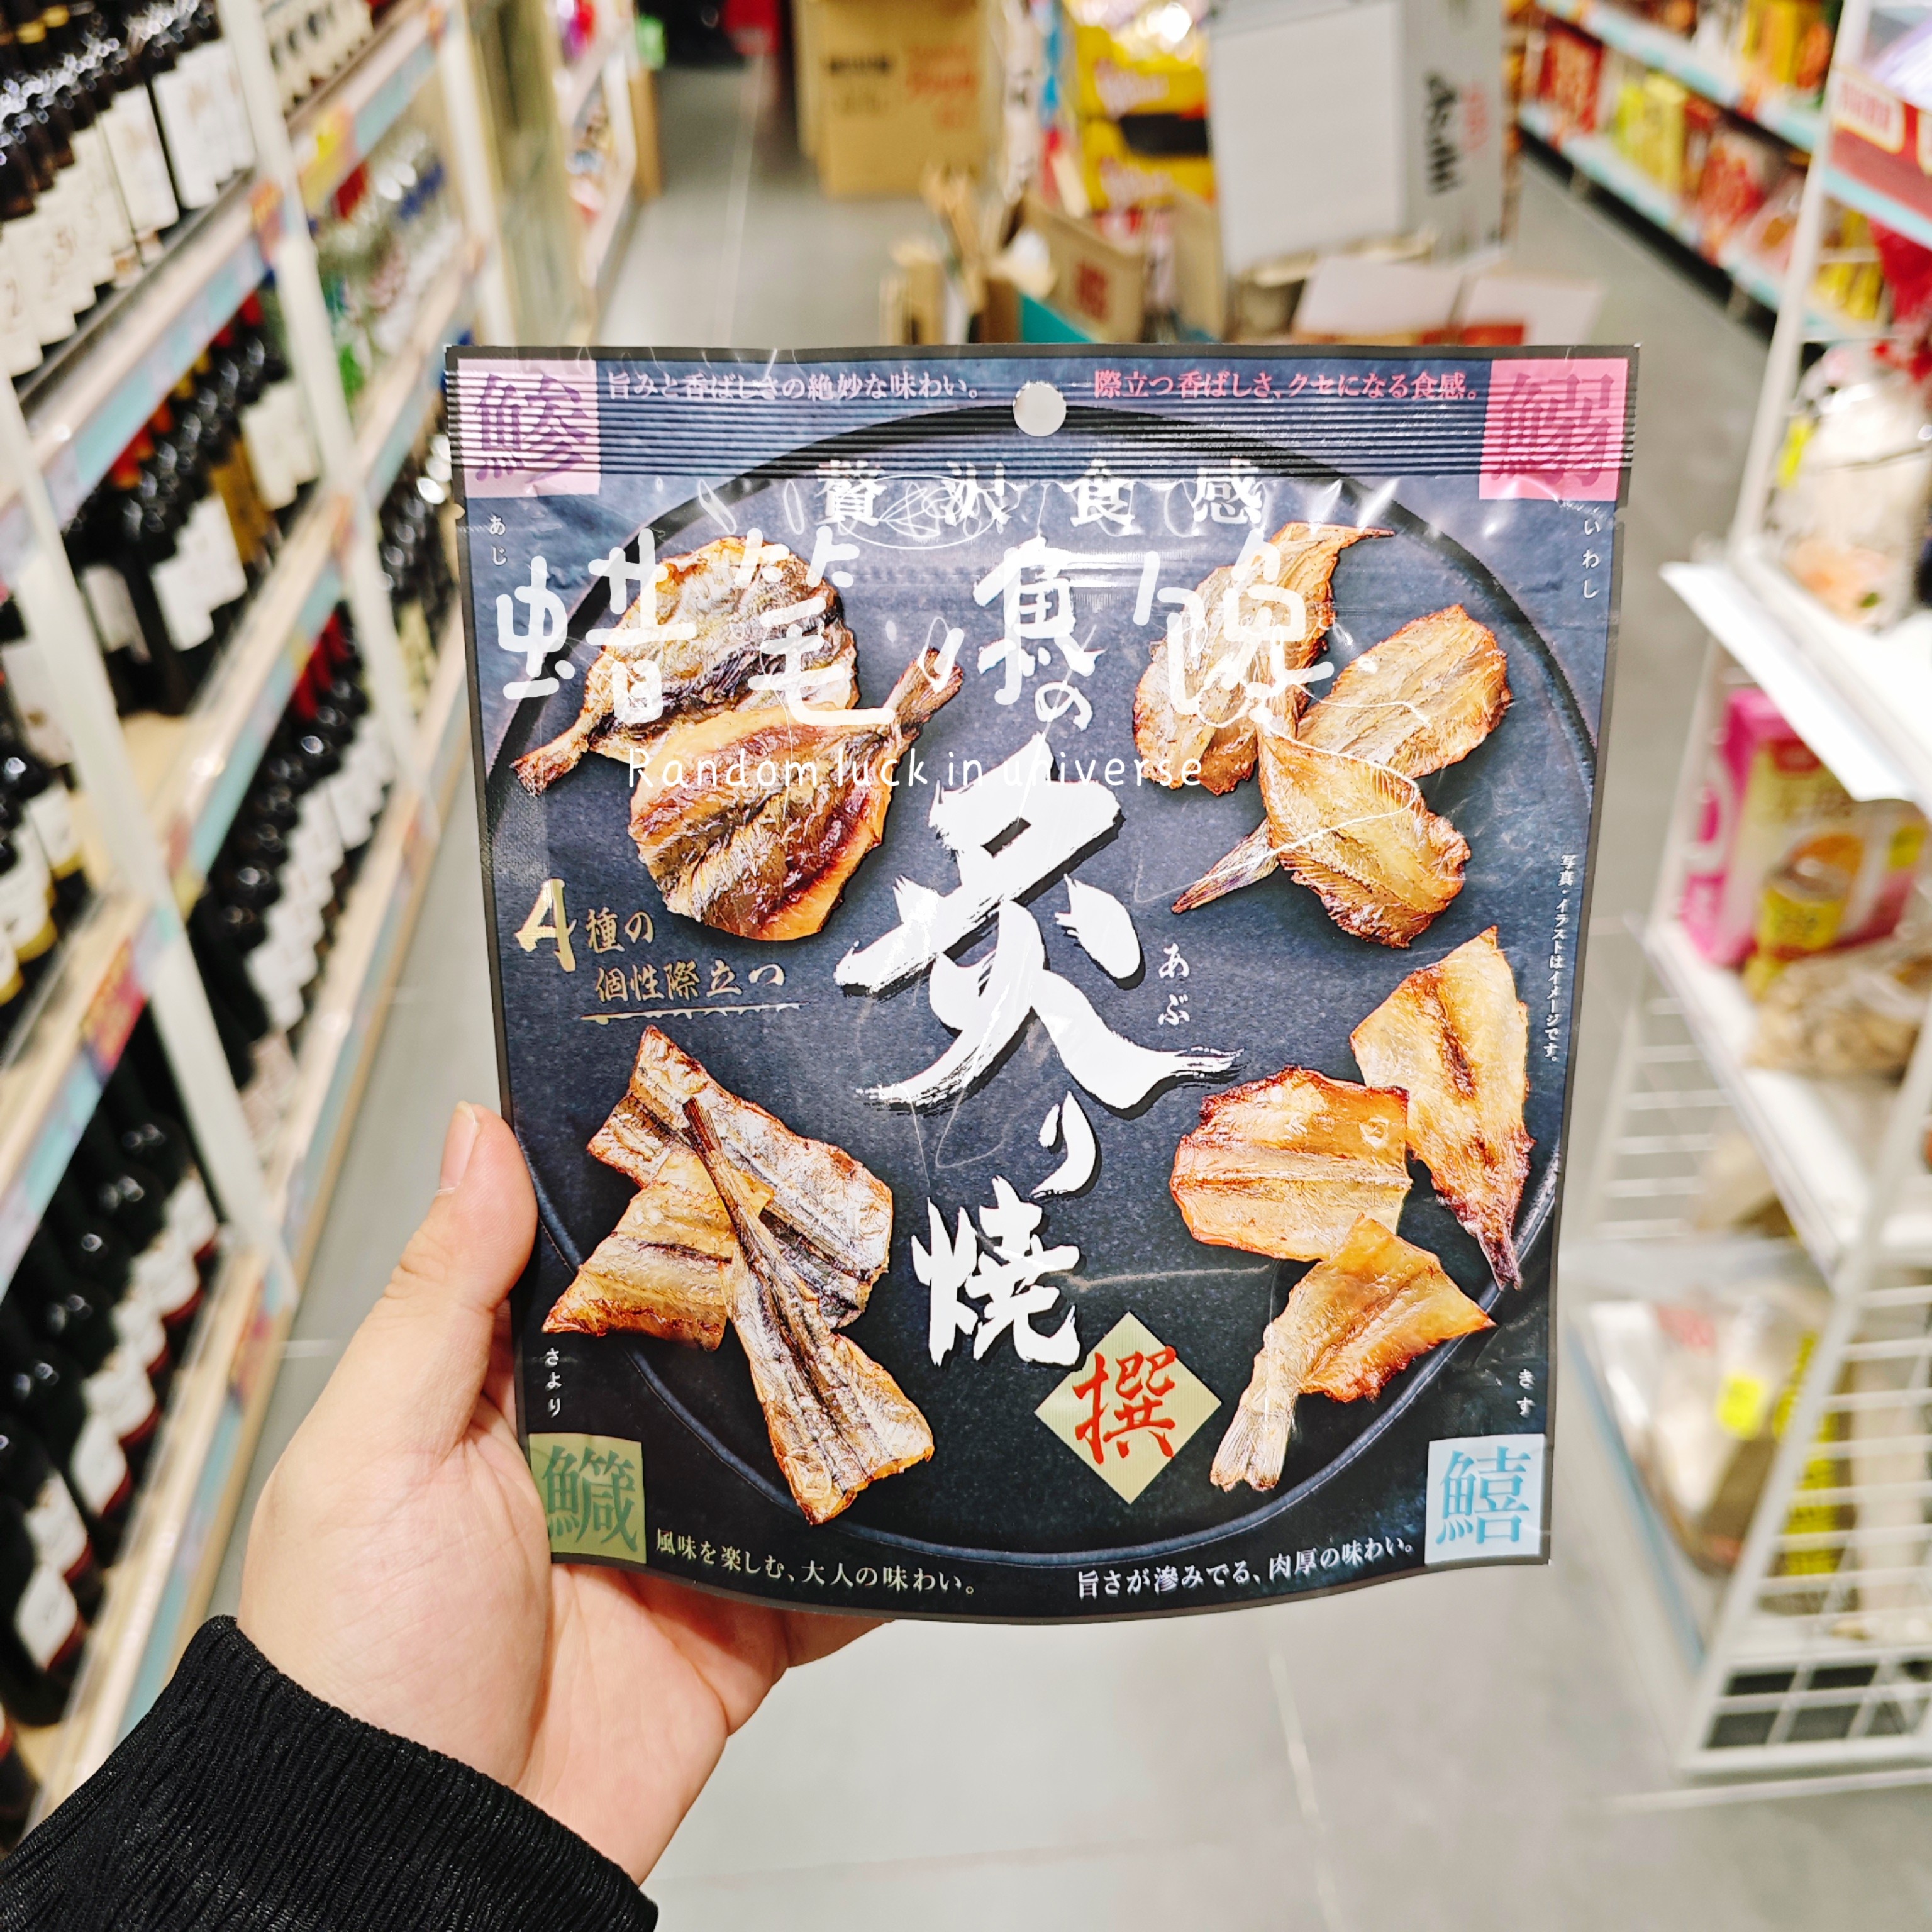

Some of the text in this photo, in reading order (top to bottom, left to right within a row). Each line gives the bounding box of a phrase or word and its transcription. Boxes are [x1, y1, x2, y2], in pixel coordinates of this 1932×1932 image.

[607, 372, 979, 402] 旨みと香ばしさの絶妙な味わい。
[1093, 370, 1478, 400] 際立つ香ばしさ、クセになる食感。
[1490, 373, 1614, 487] 鰯
[488, 514, 508, 566] あじ
[1580, 517, 1601, 599] いわし
[514, 877, 655, 973] 4種の
[1543, 853, 1576, 1063] 写真・イラストはイメージです。
[594, 958, 786, 1003] 個性際立つ
[1158, 943, 1191, 1027] あぶ
[544, 1347, 562, 1418] さより
[1072, 1345, 1177, 1465] 撰
[1516, 1368, 1536, 1418] きす
[1435, 1445, 1532, 1546] 鱚
[655, 1527, 976, 1596] 風味を楽しむ、大人の味わい。
[1077, 1536, 1415, 1600] 旨さが滲みでる、肉厚の味わい。
